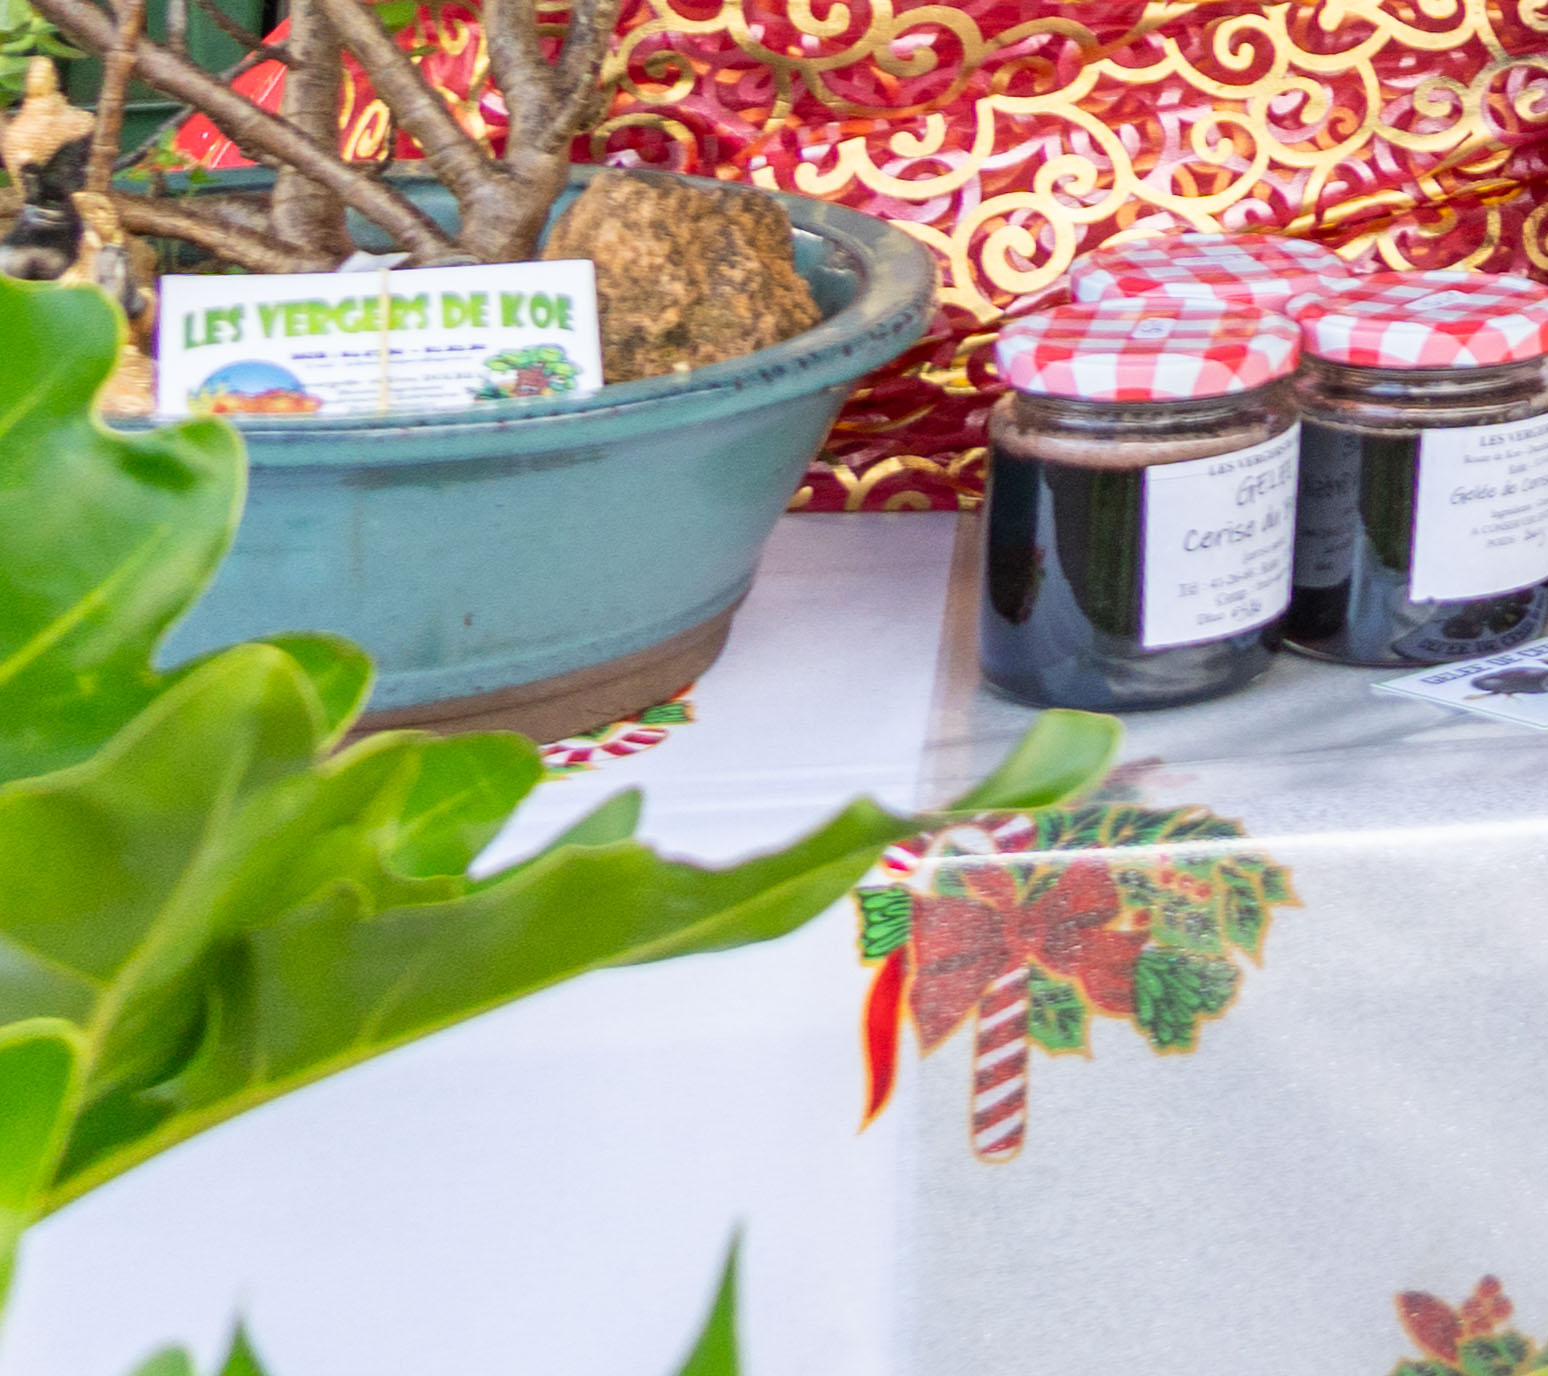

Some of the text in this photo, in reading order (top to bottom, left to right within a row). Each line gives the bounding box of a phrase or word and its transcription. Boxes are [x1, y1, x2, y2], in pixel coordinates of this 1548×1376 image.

[183, 289, 576, 350] LES VERGERS DE KOE
[1183, 519, 1255, 552] Cerise
[1421, 662, 1486, 685] GELEE
[1488, 654, 1513, 669] DE
